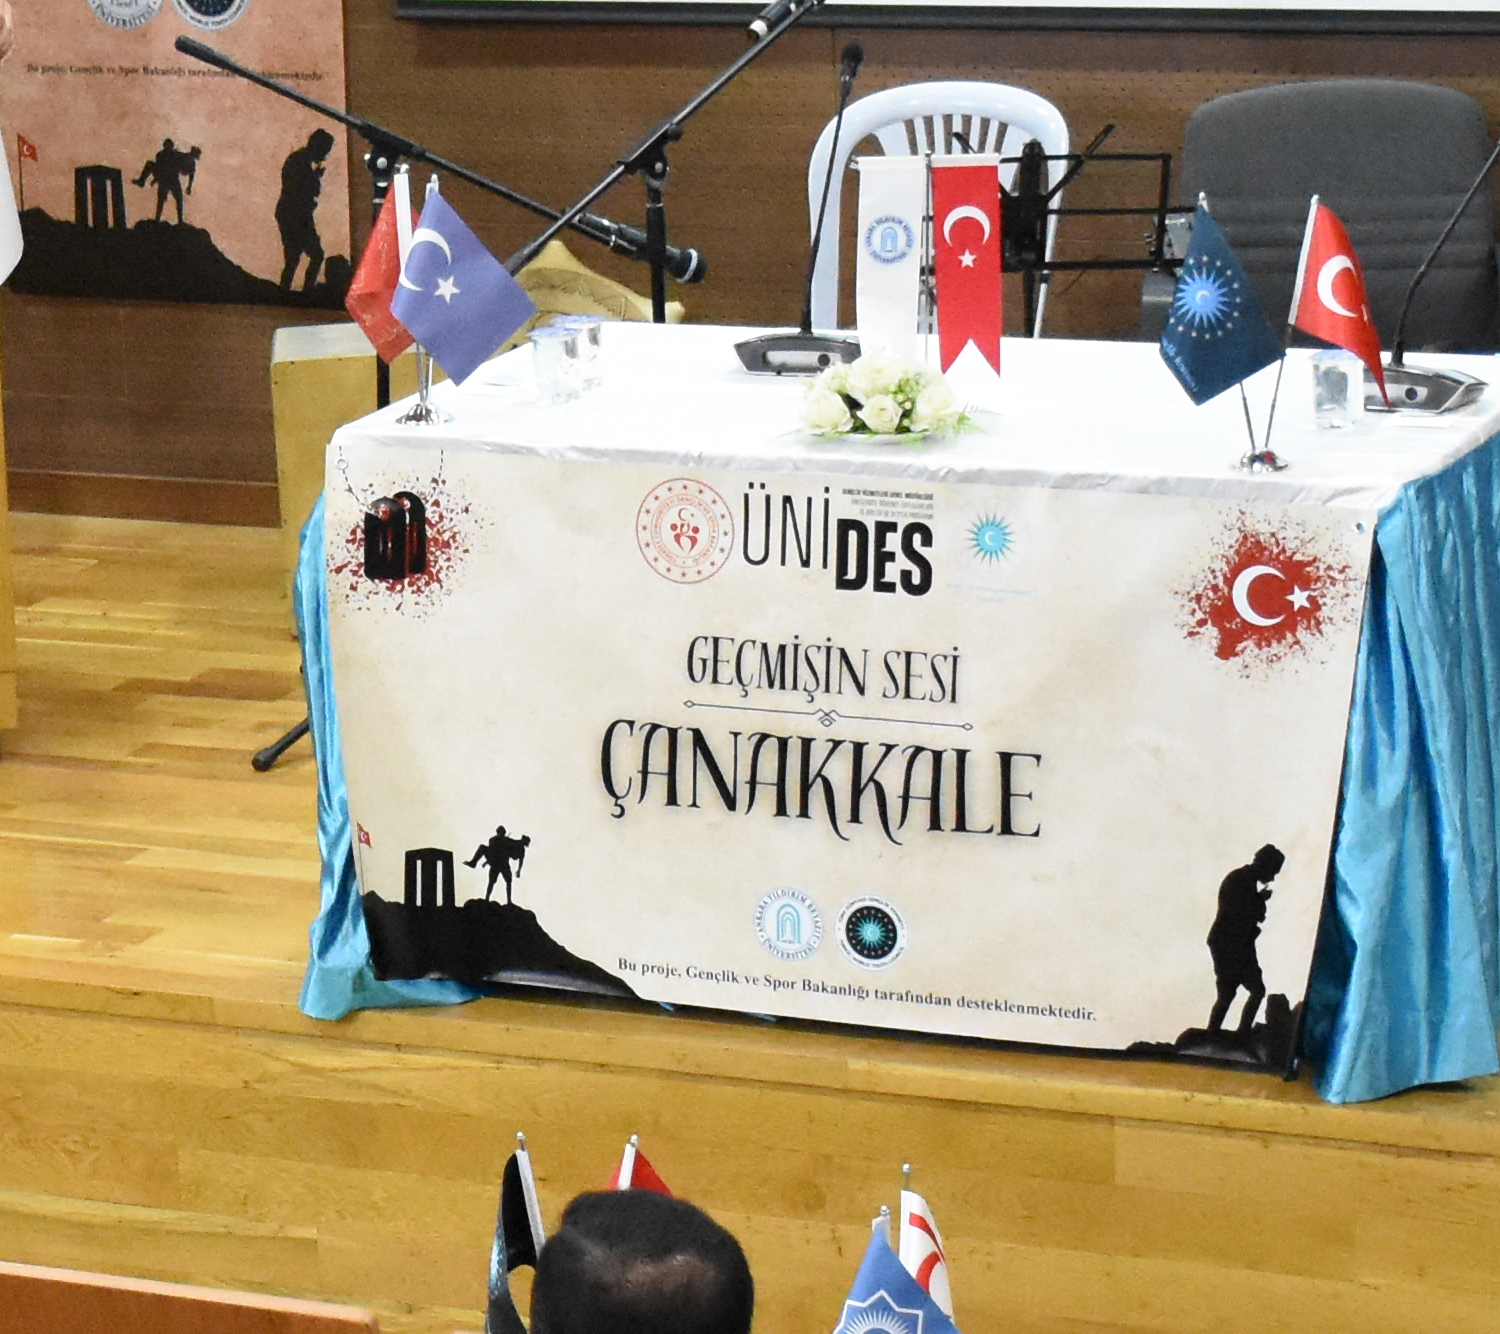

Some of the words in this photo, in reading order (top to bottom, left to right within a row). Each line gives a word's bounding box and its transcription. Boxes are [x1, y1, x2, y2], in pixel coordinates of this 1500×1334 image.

[686, 634, 869, 703] GEÇMİŞİN
[881, 646, 962, 705] SESİ
[600, 718, 1042, 846] ÇANAKKALE
[618, 957, 637, 973] Bu
[641, 959, 682, 980] proje,
[685, 965, 741, 986] Gençlik
[744, 973, 761, 987] ve
[763, 973, 799, 993] Spor
[801, 977, 871, 1002] Bakanlığı
[873, 986, 953, 1009] tarafından
[956, 992, 1099, 1023] desteklenmektedir.
